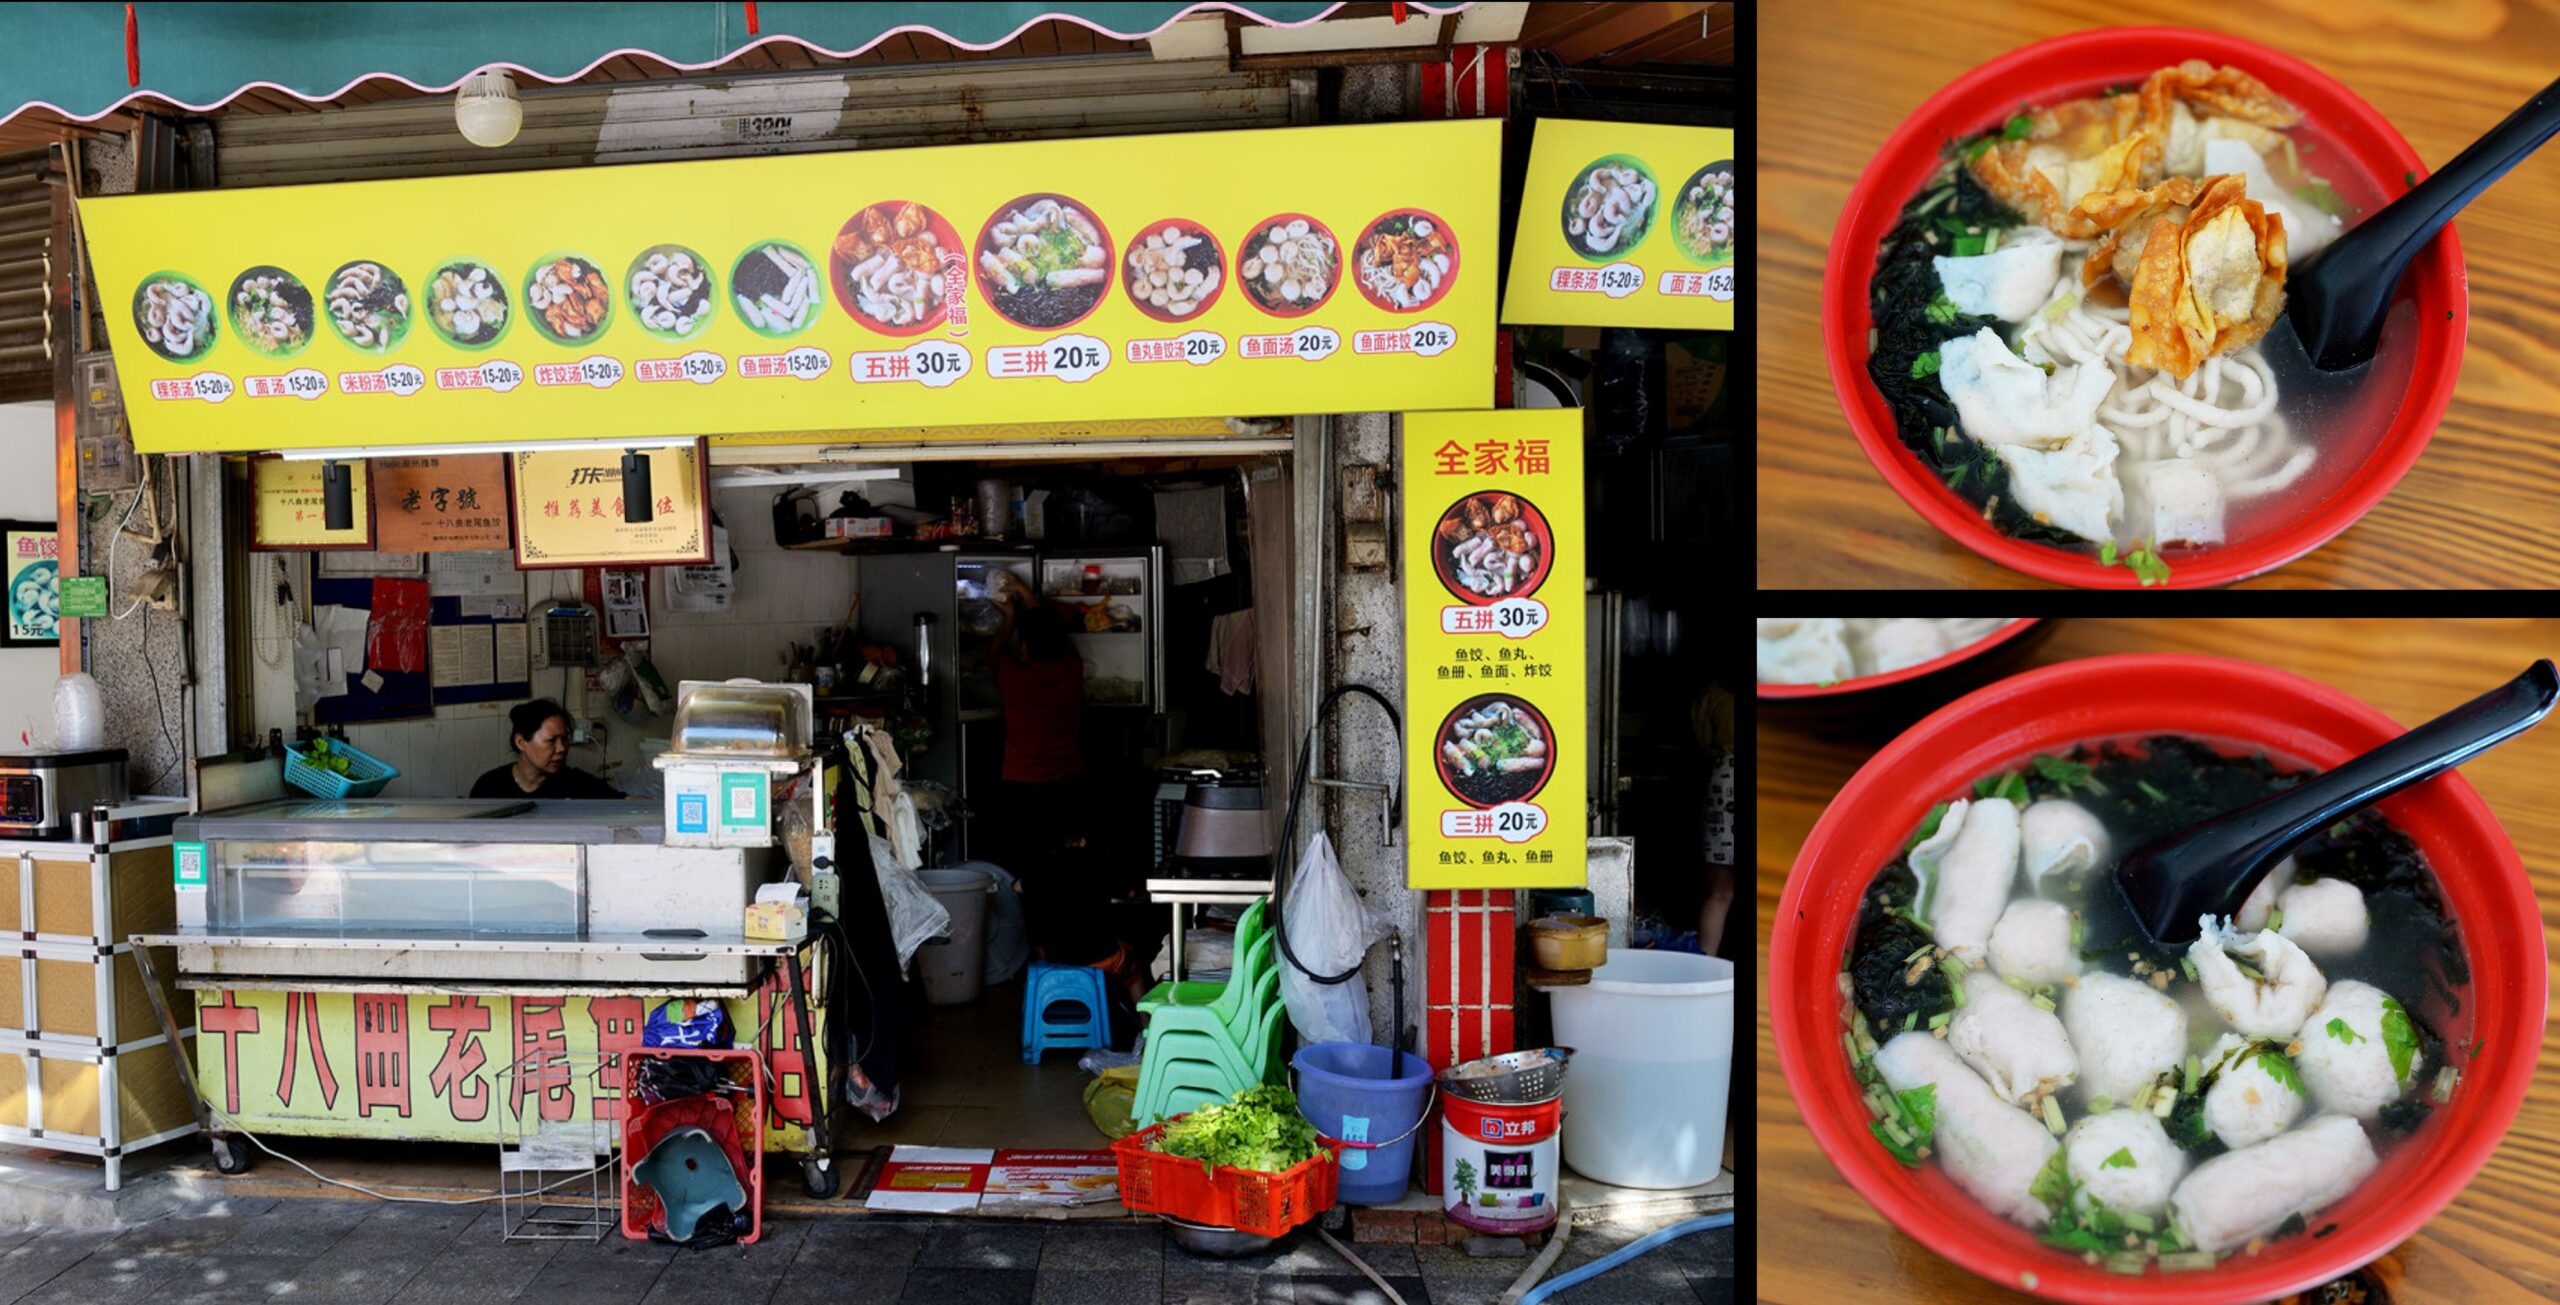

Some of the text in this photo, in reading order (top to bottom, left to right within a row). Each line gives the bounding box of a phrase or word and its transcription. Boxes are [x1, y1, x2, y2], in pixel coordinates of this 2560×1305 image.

[1601, 271, 1640, 288] 15-20元
[1131, 338, 1221, 361] 鱼丸鱼饺汤 20元
[1246, 334, 1333, 357] 鱼面汤 20元
[1361, 330, 1448, 352] 鱼面炸饺 20元
[639, 359, 724, 380] 鱼饺汤 15-20元
[743, 353, 829, 377] 鱼册汤 15-20元
[866, 351, 962, 378] 五拼 30元
[1002, 346, 1100, 374] 三拼 20元
[289, 375, 326, 393] 15-20元
[344, 371, 422, 392] 米粉汤 15-20元
[440, 367, 521, 388] 面饺汤 15-20元
[538, 363, 621, 384] 炸饺汤 15-20元
[195, 376, 232, 395] 15-20元
[1434, 439, 1551, 476] 全家福
[1455, 607, 1539, 630] 五拼 30元
[13, 623, 44, 637] 15元
[1454, 812, 1538, 834] 三拼 20元
[1439, 850, 1553, 865] 鱼饺、鱼丸、鱼册
[1504, 1120, 1536, 1136] 立邦
